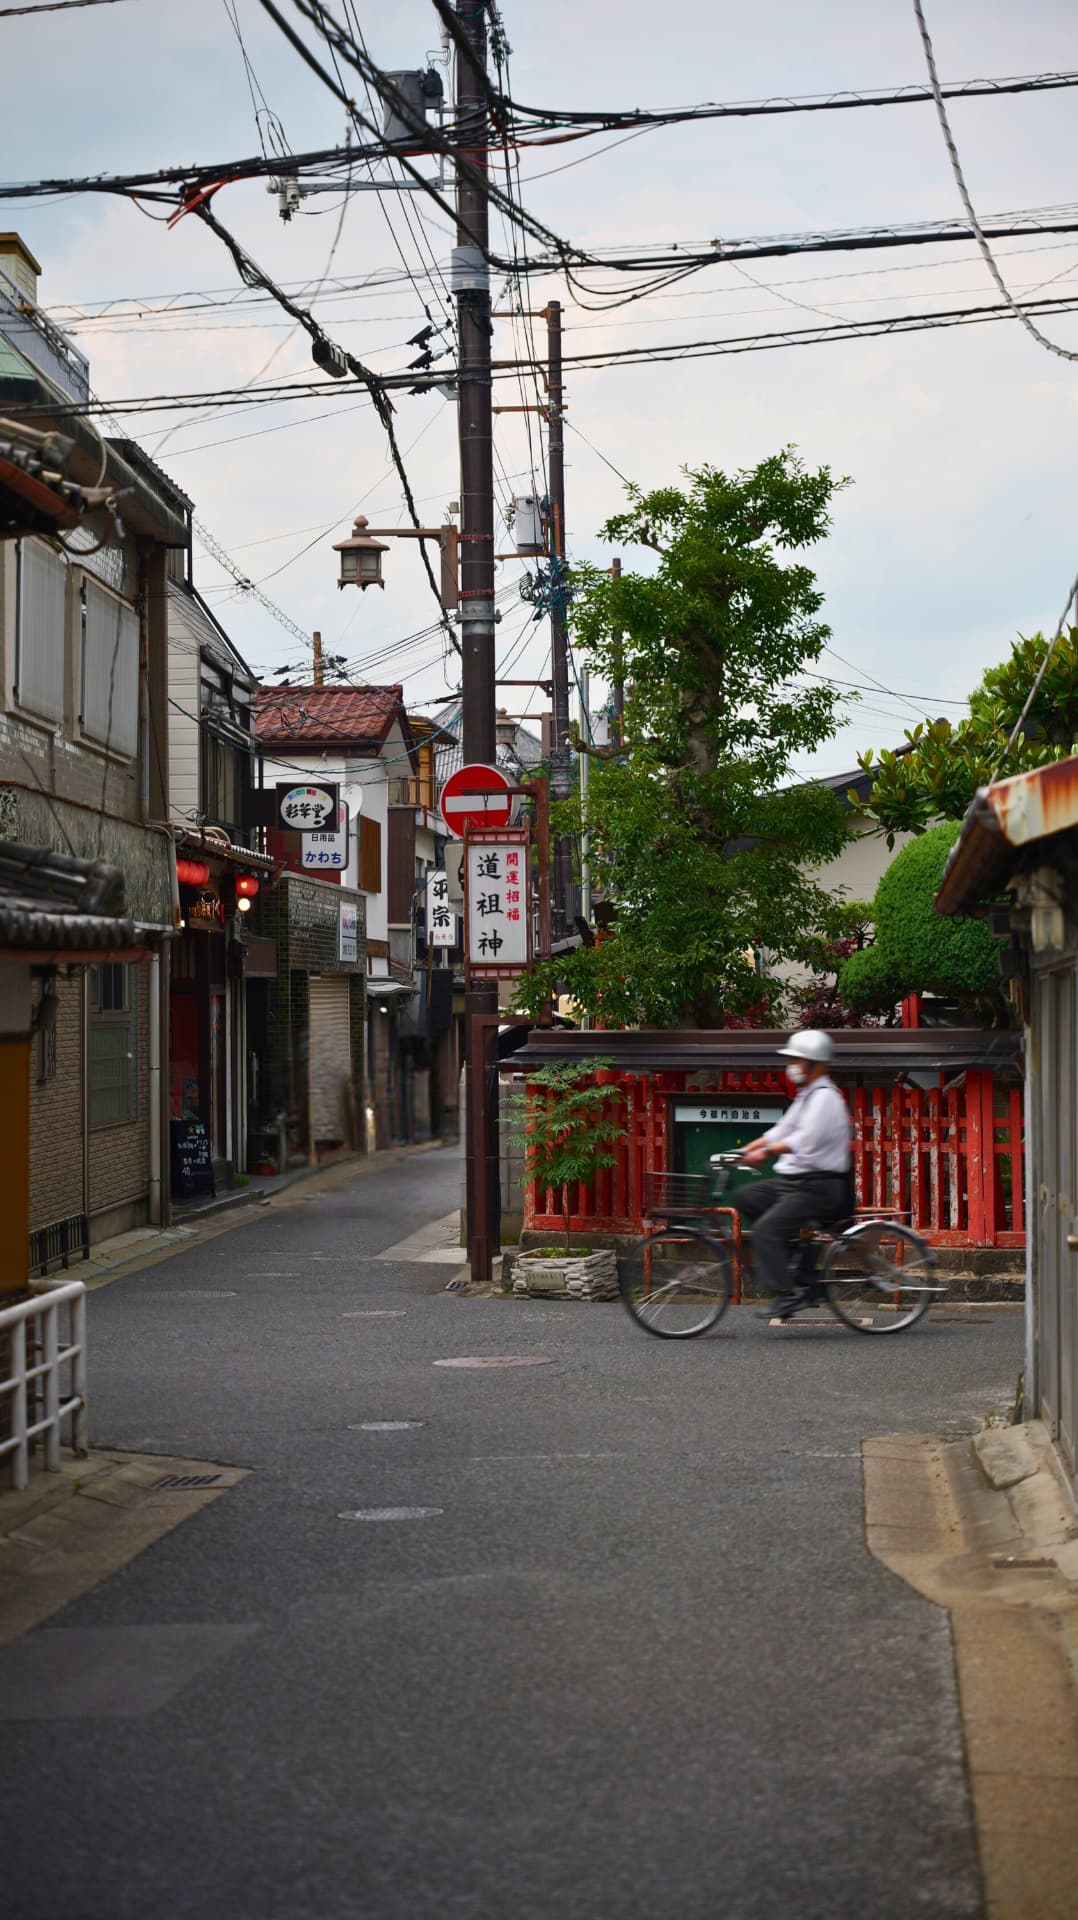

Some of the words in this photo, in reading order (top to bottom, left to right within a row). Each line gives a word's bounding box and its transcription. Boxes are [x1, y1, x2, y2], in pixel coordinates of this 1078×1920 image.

[305, 850, 342, 864] かわち
[311, 833, 335, 842] 日用品
[432, 879, 450, 928] 平宗
[476, 852, 504, 957] 道祖神
[506, 852, 520, 922] 開運招福
